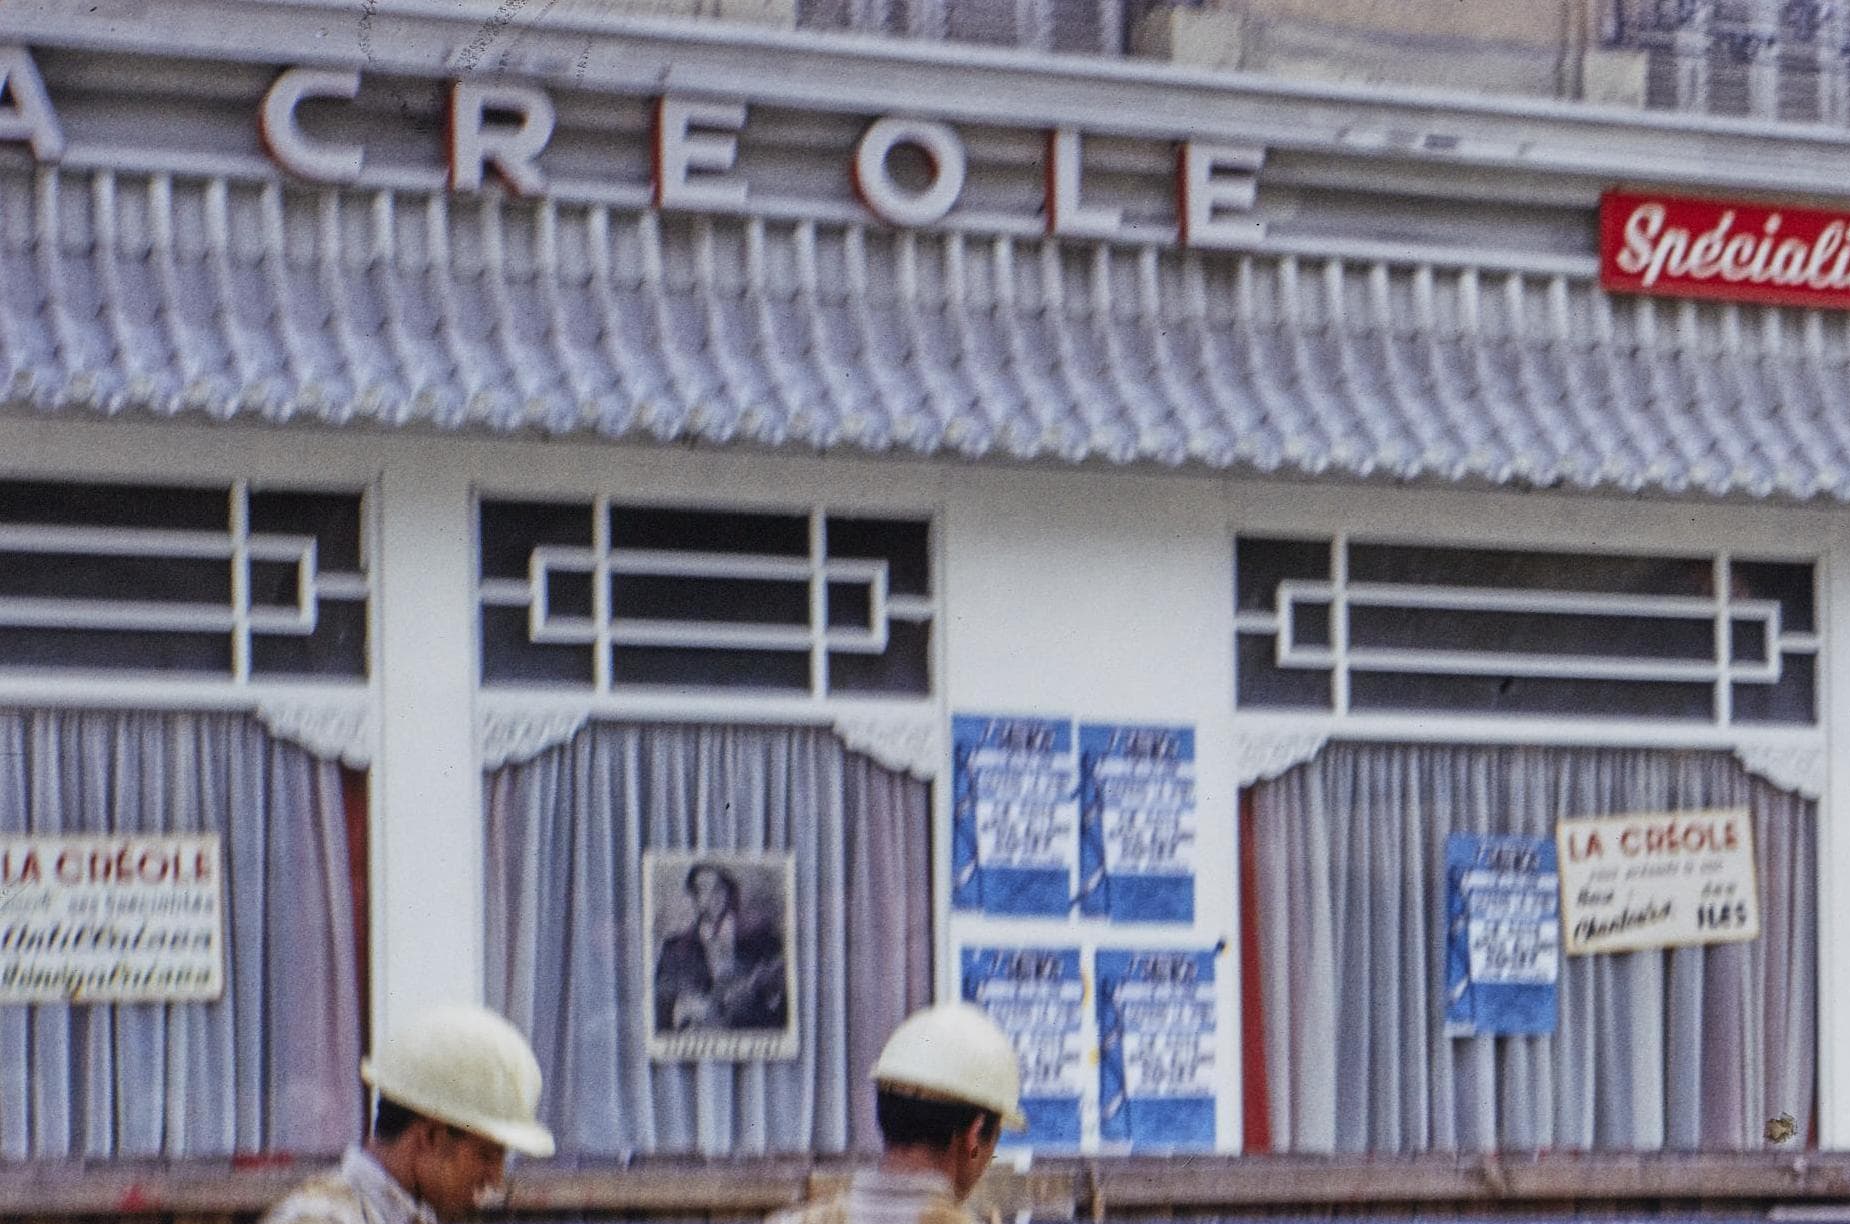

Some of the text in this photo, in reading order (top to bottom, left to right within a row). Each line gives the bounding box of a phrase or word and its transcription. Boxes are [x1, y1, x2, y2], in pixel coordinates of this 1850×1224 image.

[257, 66, 1267, 246] CREOLE
[1569, 830, 1602, 862] LA
[2, 850, 41, 884] LA
